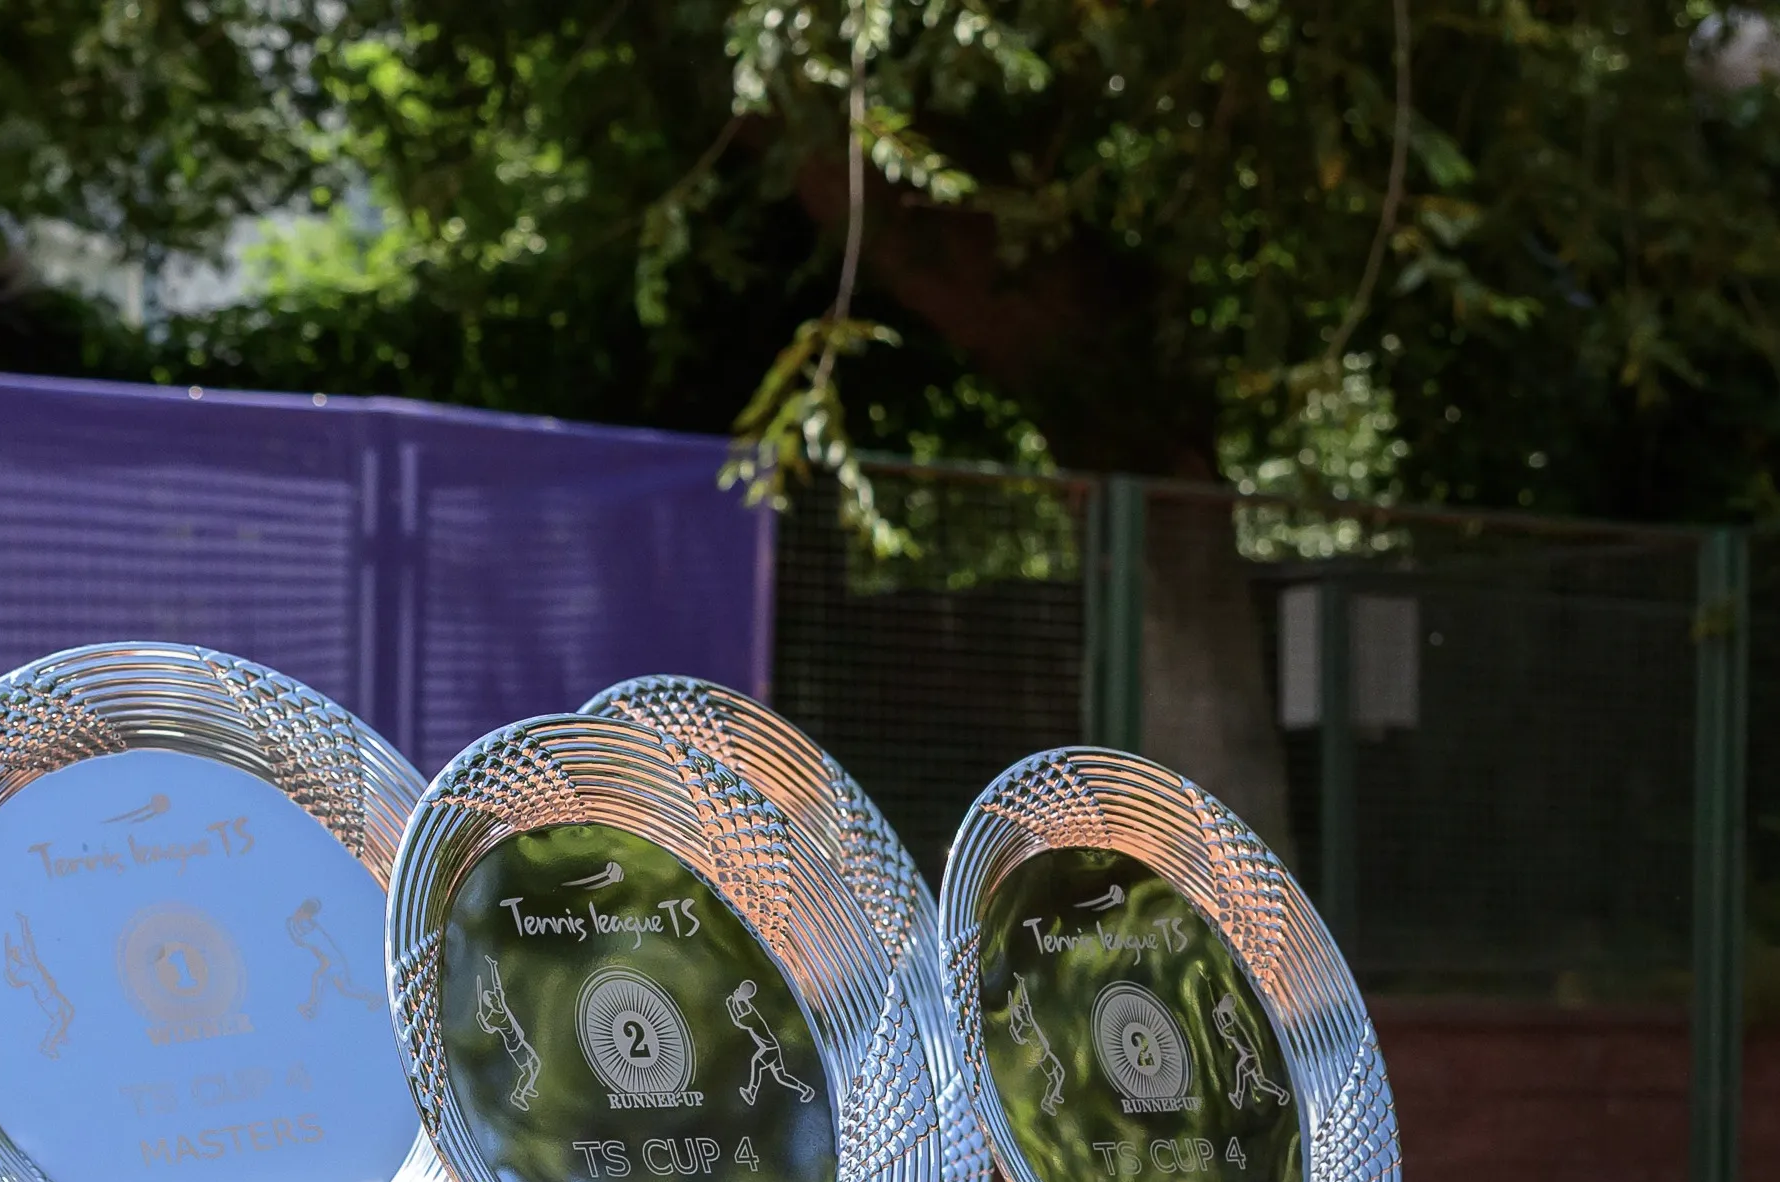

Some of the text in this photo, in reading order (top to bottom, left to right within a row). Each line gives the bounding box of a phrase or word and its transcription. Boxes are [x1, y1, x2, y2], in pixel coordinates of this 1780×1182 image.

[206, 816, 255, 858] TS
[499, 897, 700, 950] Tennis league TS
[1023, 917, 1189, 966] Tennis league TS
[167, 950, 198, 988] 1
[622, 1020, 652, 1059] 2
[1130, 1032, 1155, 1067] 2
[607, 1091, 705, 1109] RUNNER-UP
[1121, 1097, 1203, 1113] RUNNER-UP
[139, 1112, 325, 1169] MASTERS
[572, 1136, 760, 1178] TS CUP 4
[1092, 1136, 1247, 1176] TS CUP 4
